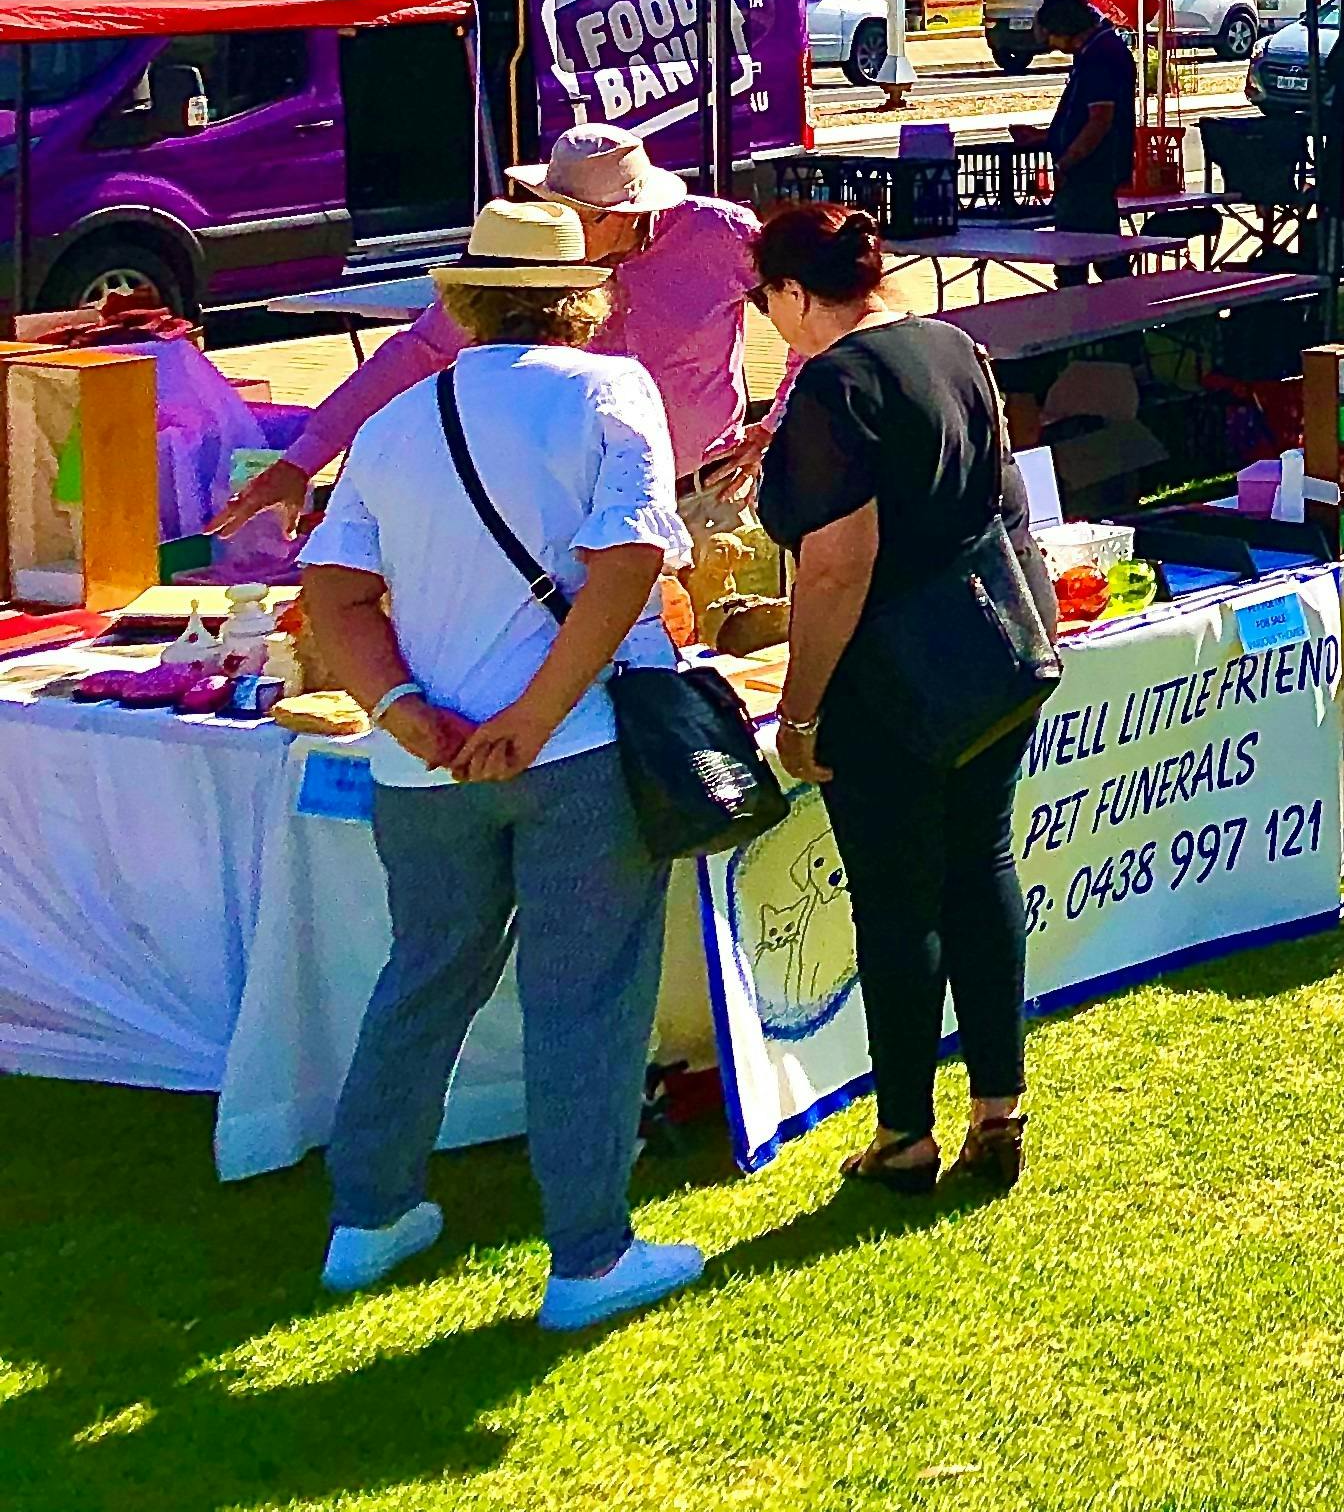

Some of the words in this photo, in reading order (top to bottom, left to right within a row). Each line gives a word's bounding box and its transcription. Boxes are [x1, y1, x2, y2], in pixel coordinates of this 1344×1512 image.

[1028, 701, 1109, 778] WELL
[1118, 667, 1217, 746] LITTLE
[1216, 634, 1339, 711] FRIEND
[1022, 787, 1090, 860] PET
[1091, 731, 1259, 835] FUNERALS
[1066, 841, 1157, 920] 0438
[1170, 816, 1248, 891] 997
[1264, 799, 1323, 863] 121
